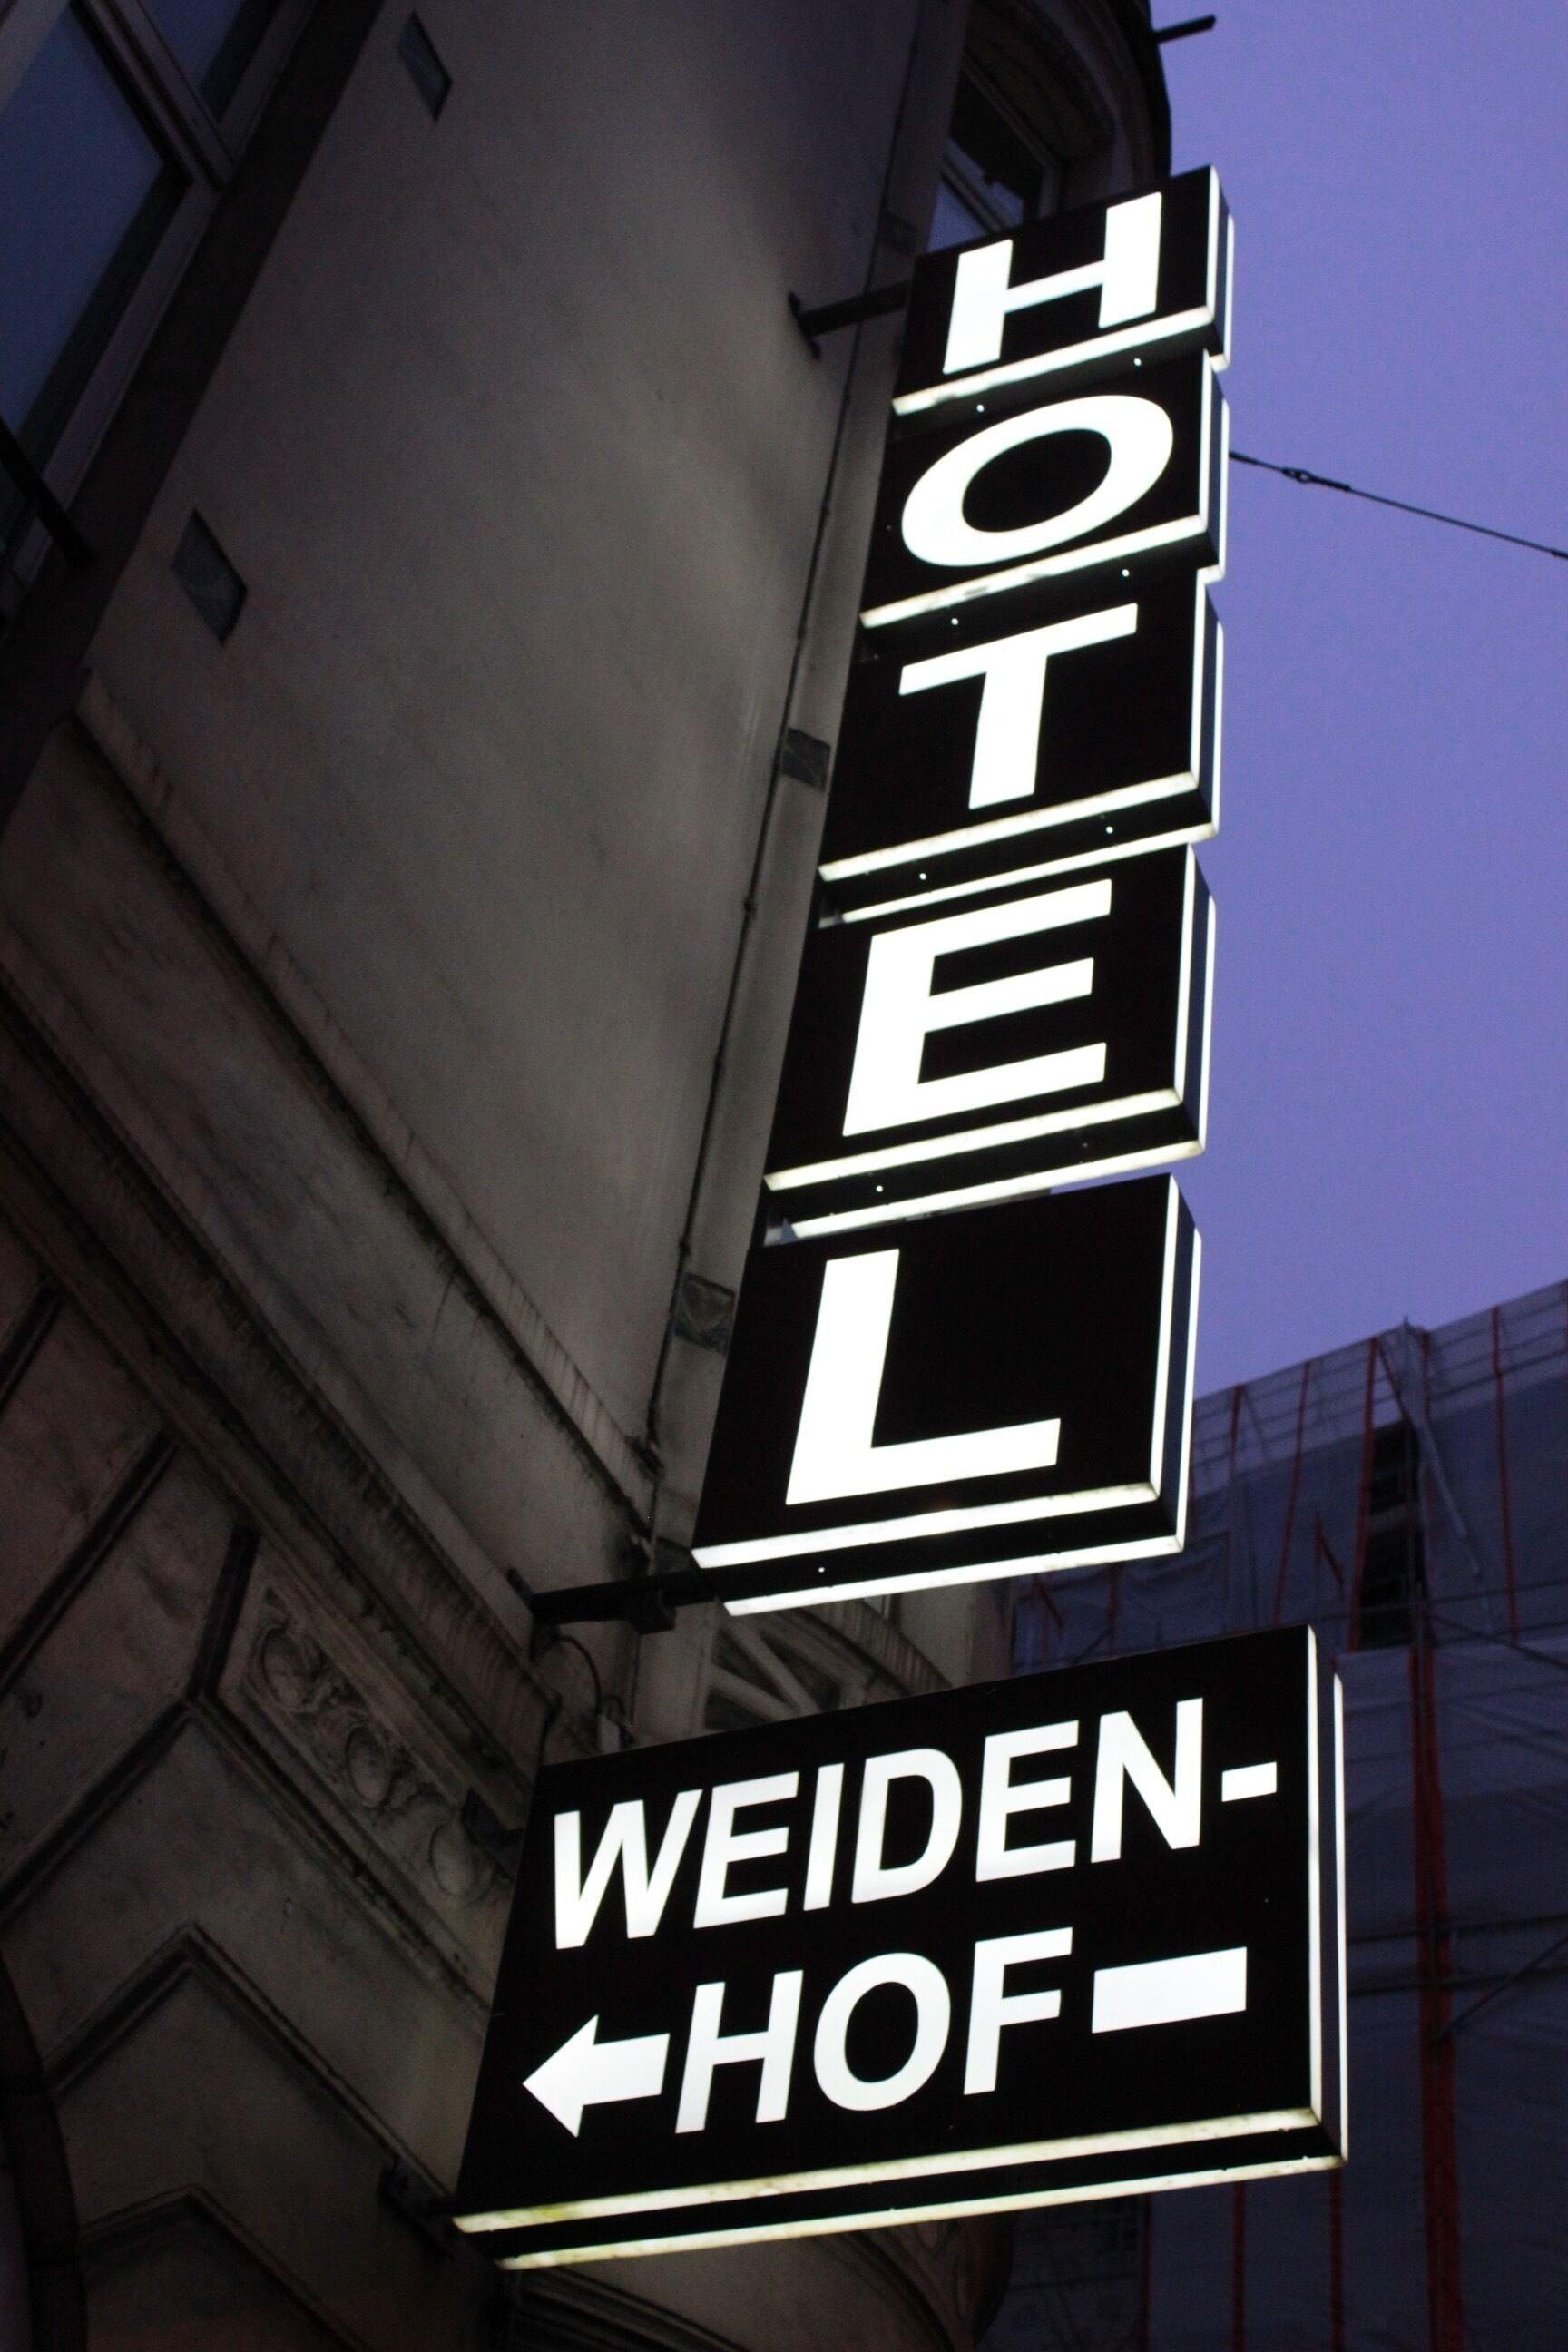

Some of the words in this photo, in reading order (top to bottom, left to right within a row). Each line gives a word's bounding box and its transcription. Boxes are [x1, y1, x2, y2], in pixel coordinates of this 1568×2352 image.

[785, 191, 1174, 1506] HOTEL
[554, 1698, 1279, 1951] WEIDEN-
[674, 1926, 1074, 2135] HOF
